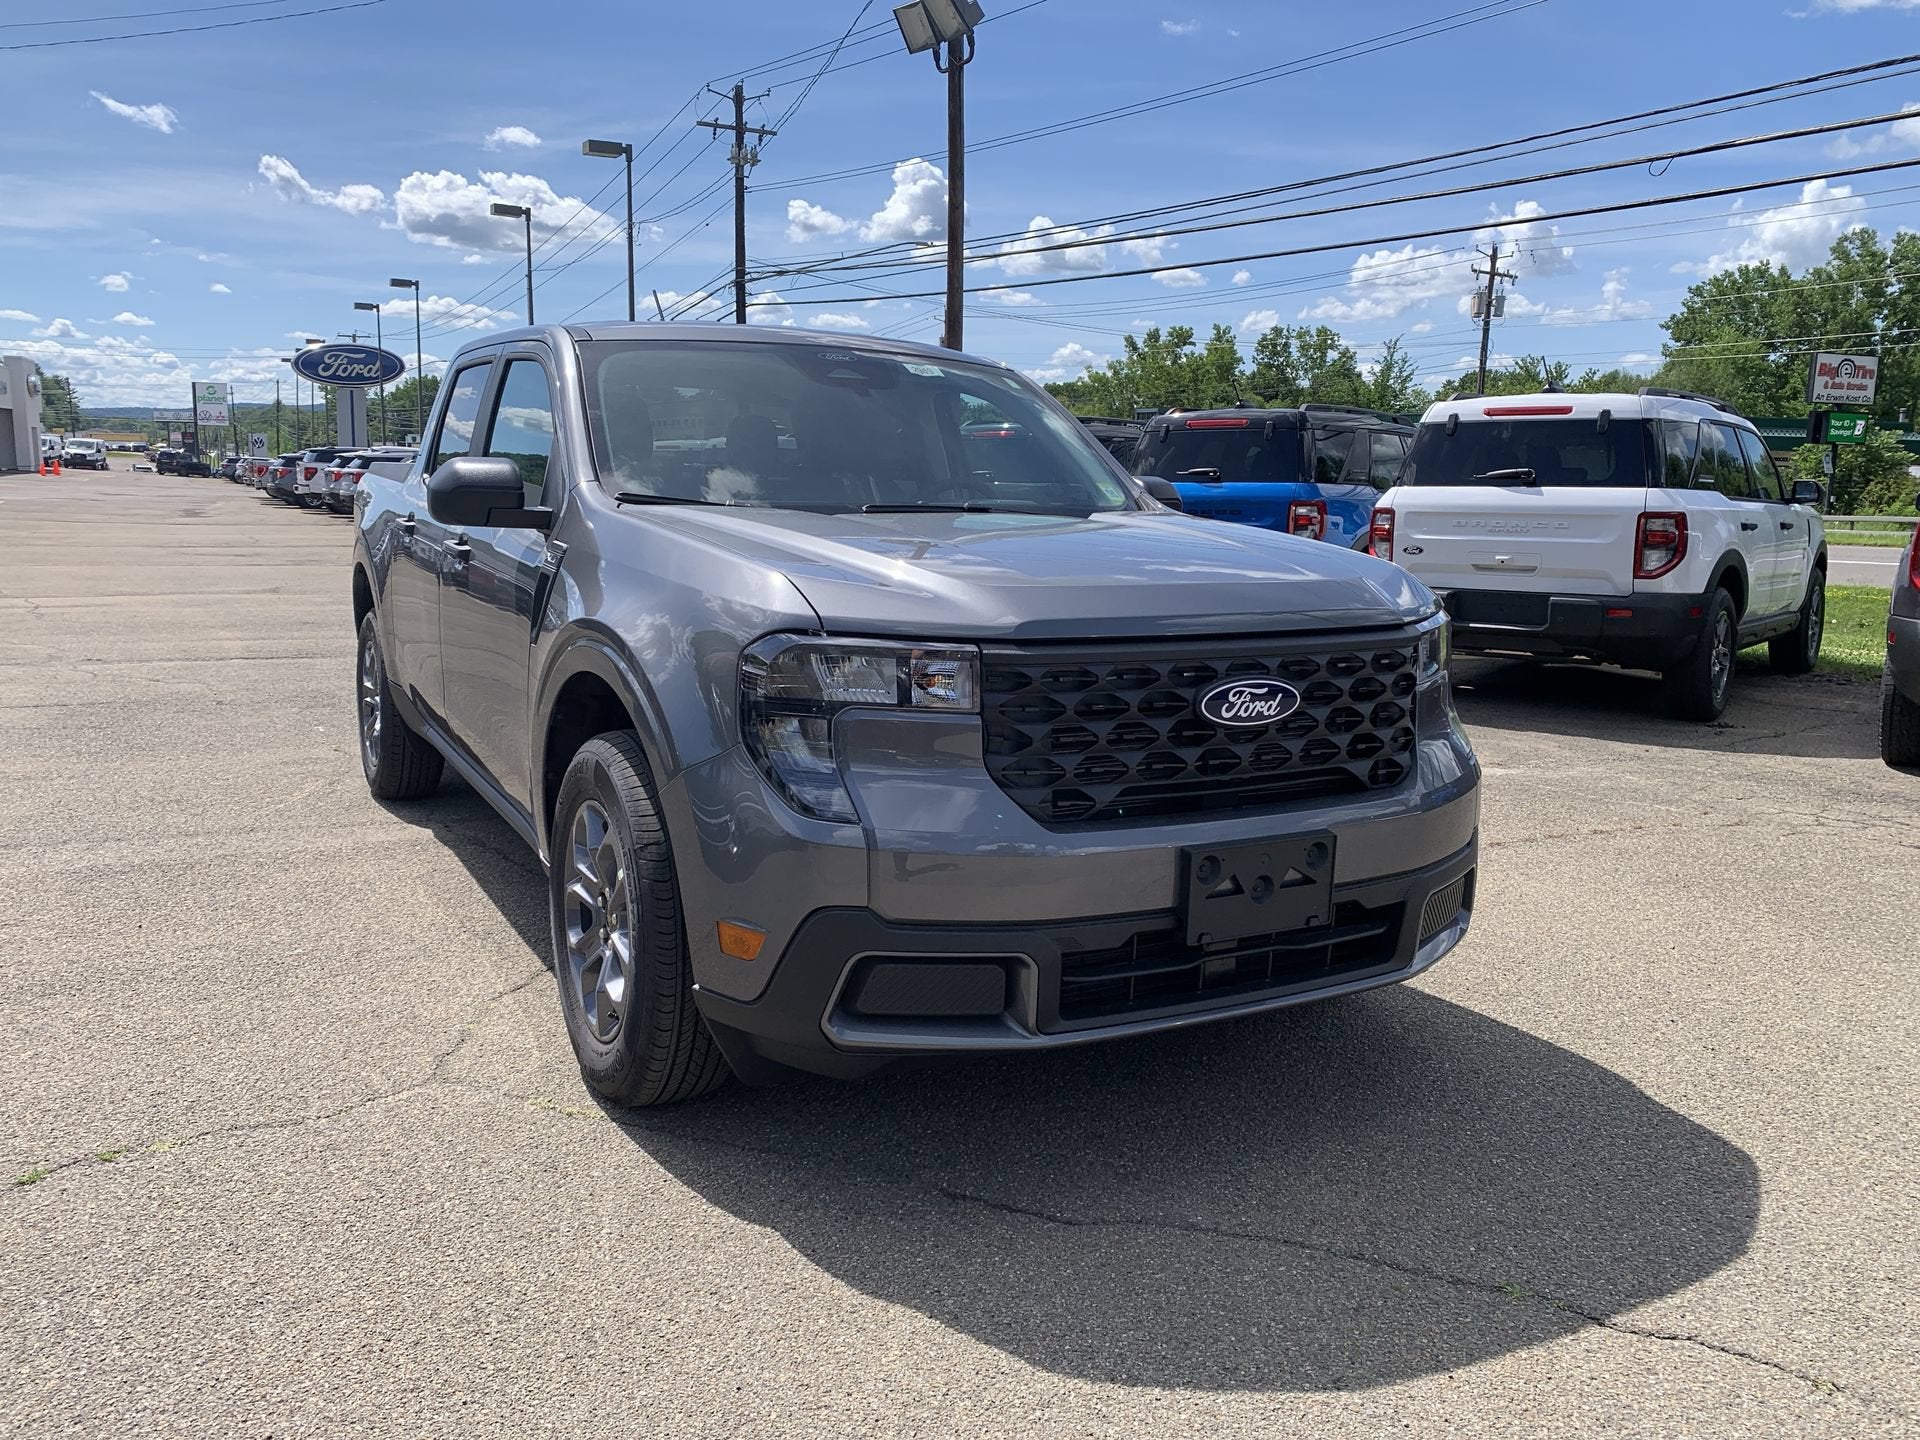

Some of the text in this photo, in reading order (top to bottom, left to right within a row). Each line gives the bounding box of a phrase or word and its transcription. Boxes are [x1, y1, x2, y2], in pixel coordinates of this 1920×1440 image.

[317, 351, 381, 377] Ford
[1817, 362, 1837, 380] Big
[1815, 393, 1825, 401] An
[1846, 394, 1861, 402] Kost
[1831, 419, 1843, 427] Your
[1830, 428, 1853, 437] Savings!
[1452, 519, 1570, 529] BRONCO
[1221, 687, 1283, 718] Ford
